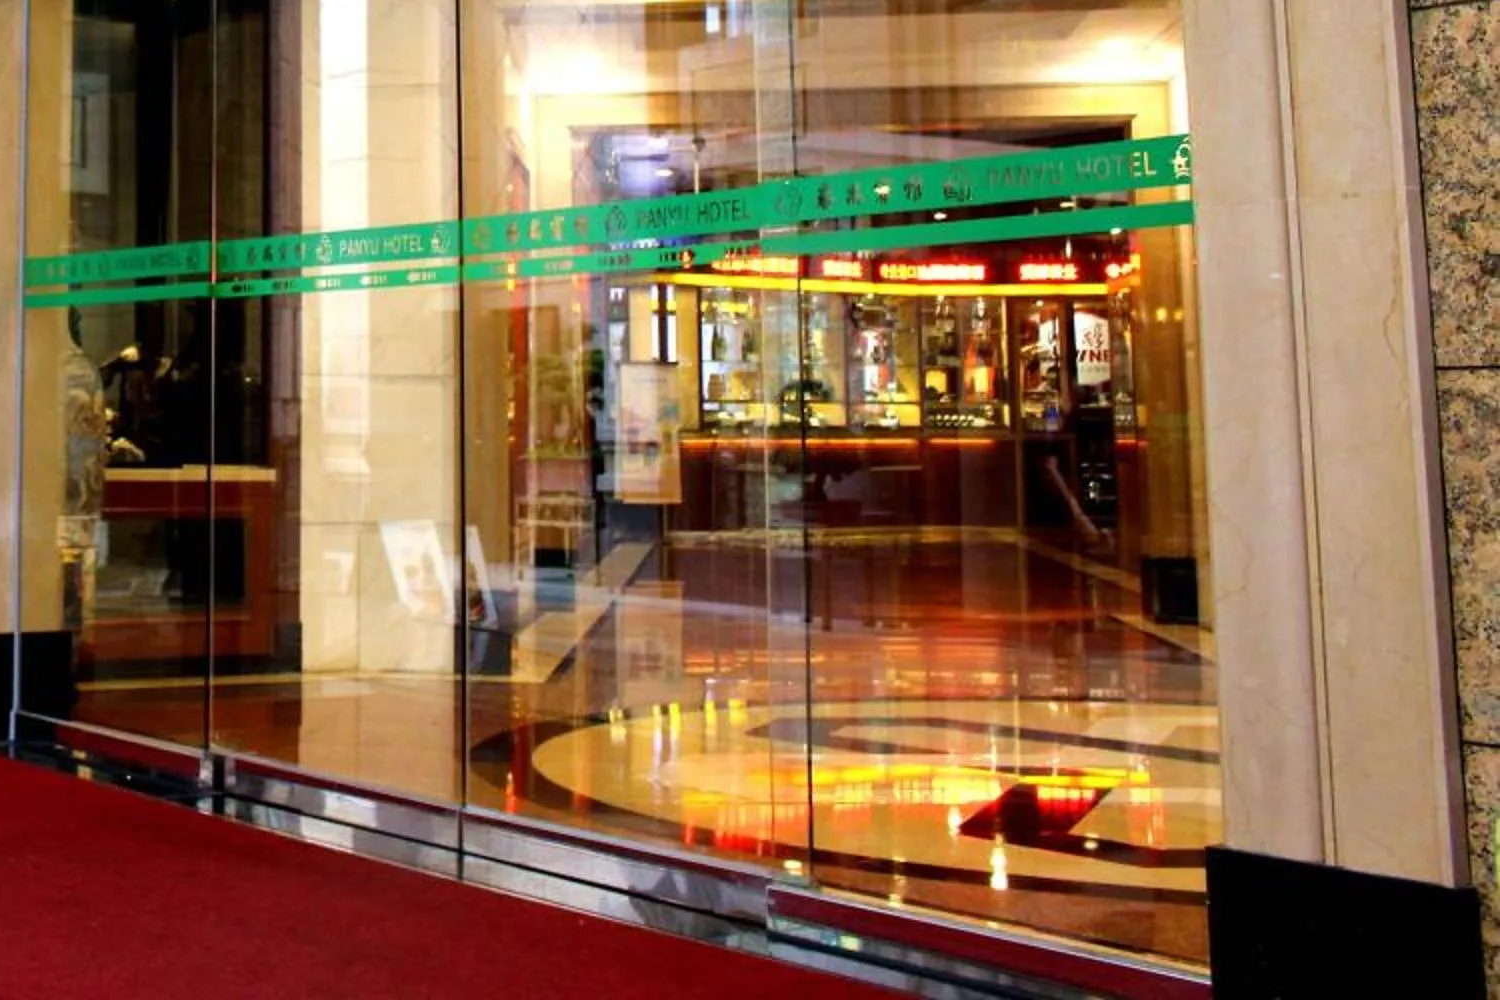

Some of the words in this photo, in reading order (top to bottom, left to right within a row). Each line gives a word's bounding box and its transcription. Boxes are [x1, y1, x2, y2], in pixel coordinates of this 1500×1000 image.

[988, 161, 1064, 191] PANYU
[1075, 151, 1157, 181] HOTEL
[696, 198, 751, 224] HOTEL
[383, 232, 425, 255] HOTEL
